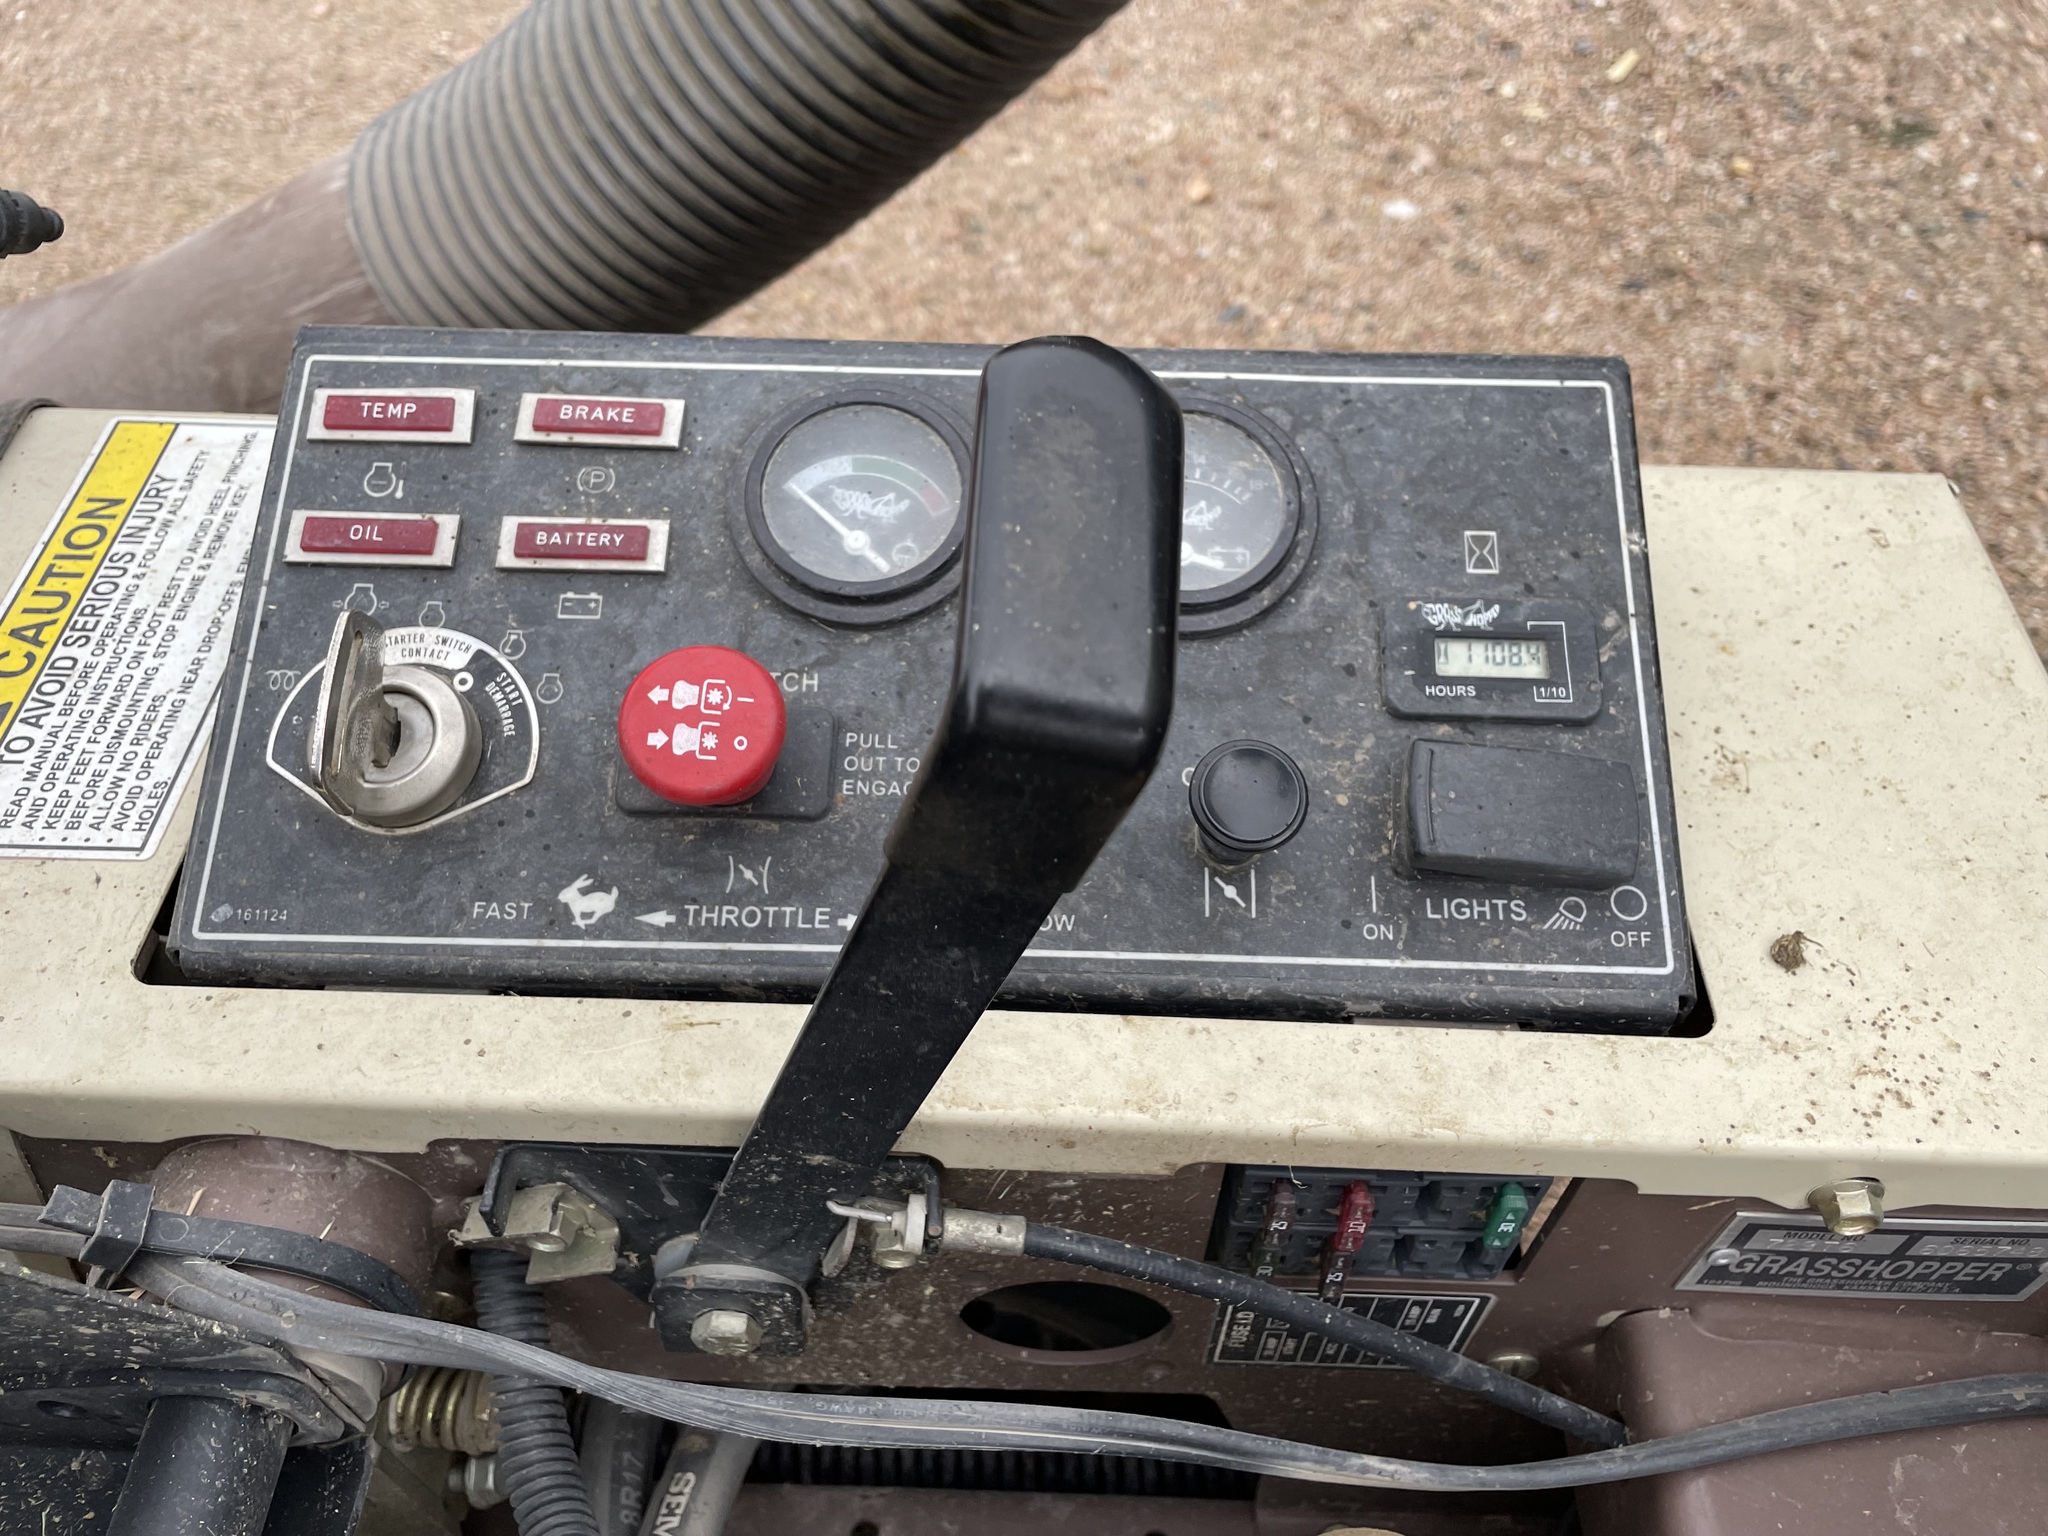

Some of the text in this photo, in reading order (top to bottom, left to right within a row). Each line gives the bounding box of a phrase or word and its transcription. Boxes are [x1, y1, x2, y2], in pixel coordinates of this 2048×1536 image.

[360, 402, 418, 420] TEMP
[559, 404, 636, 424] BRAKE
[349, 524, 384, 542] OIL
[535, 531, 625, 547] BATTERY
[0, 498, 126, 678] CAUTION
[0, 474, 178, 764] TO AVOID SERIOUS INJURY
[0, 787, 31, 829] READ
[22, 720, 68, 782] MANUAL
[57, 661, 99, 717] BEFORE
[91, 583, 139, 658] OPERATING
[137, 517, 175, 569] FOLLOW
[167, 494, 188, 517] ALL
[179, 449, 210, 492] SAFETY
[434, 634, 473, 654] SWITCH
[42, 789, 72, 830] KEEP
[65, 748, 96, 785] FEET
[87, 673, 134, 749] FORWARD
[126, 650, 148, 671] ON
[138, 611, 166, 647] FOOT
[157, 577, 186, 609] REST
[176, 556, 194, 576] TO
[187, 517, 214, 554] AVOID
[205, 486, 231, 517] HEEL
[401, 648, 450, 661] CONTACT
[64, 769, 109, 830] BEFORE
[98, 662, 164, 765] DISMOUNTING,
[153, 624, 179, 660] STOP
[171, 574, 207, 622] ENGINE
[203, 509, 239, 560] REMOVE
[496, 671, 523, 706] START
[1424, 685, 1477, 698] HOURS
[1539, 686, 1567, 699] 1/10
[21, 604, 150, 830] AND OPERATING INSTRUCTIONS.
[484, 681, 516, 738] DEMARRAGE
[111, 785, 144, 832] AVOID
[135, 697, 187, 781] OPERATING
[176, 656, 208, 694] NEAR
[844, 732, 899, 750] PULL
[89, 691, 168, 831] ALLOW NO RIDERS.
[843, 755, 921, 774] OUT TO
[131, 777, 171, 832] HOLES.
[235, 908, 288, 922] 161124
[472, 901, 534, 920] FAST
[683, 904, 832, 929] THROTTLE
[1425, 897, 1528, 922] LIGHTS
[1039, 914, 1076, 932] OW
[1362, 922, 1394, 941] ON
[1609, 930, 1652, 948] OFF
[1269, 1220, 1289, 1231] 25
[1347, 1220, 1367, 1234] 10
[1783, 1231, 1837, 1241] MODEL
[1950, 1237, 2033, 1247] SERIAL NO.
[1728, 1253, 2014, 1282] GRASSHOPPER
[1325, 1271, 1344, 1284] 25
